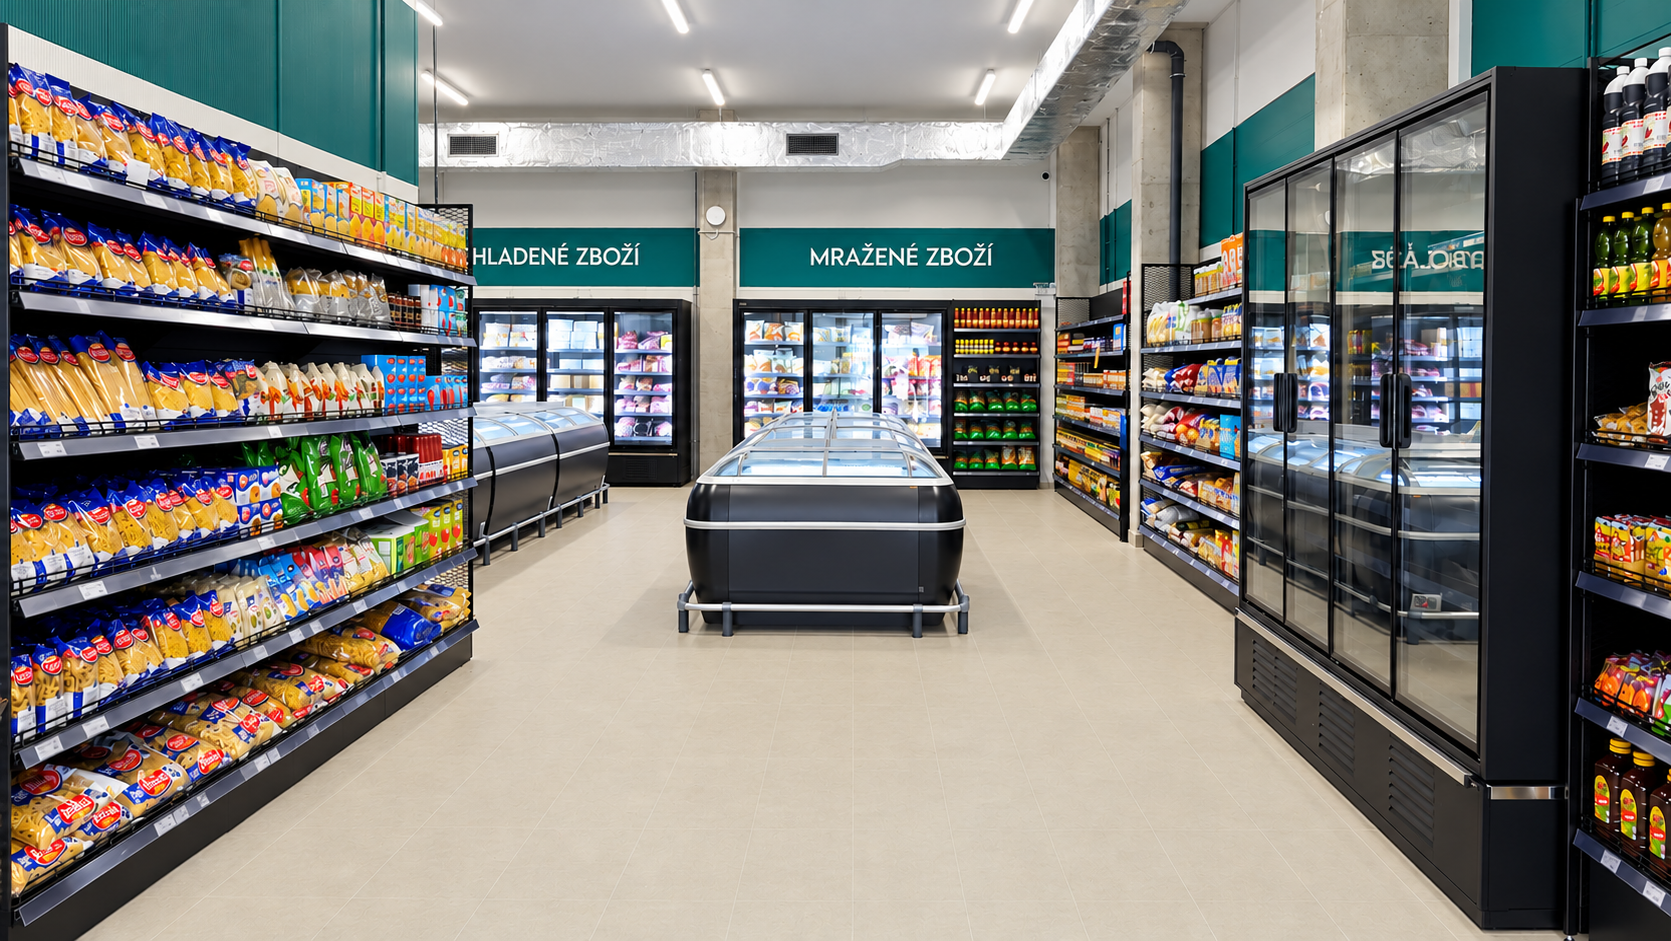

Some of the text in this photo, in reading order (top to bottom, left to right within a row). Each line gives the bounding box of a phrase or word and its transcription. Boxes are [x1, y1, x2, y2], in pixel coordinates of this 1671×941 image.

[465, 243, 641, 266] HLADENÉ ZBOŽÍ
[810, 242, 994, 267] MRAŽENÉ ZBOŽÍ
